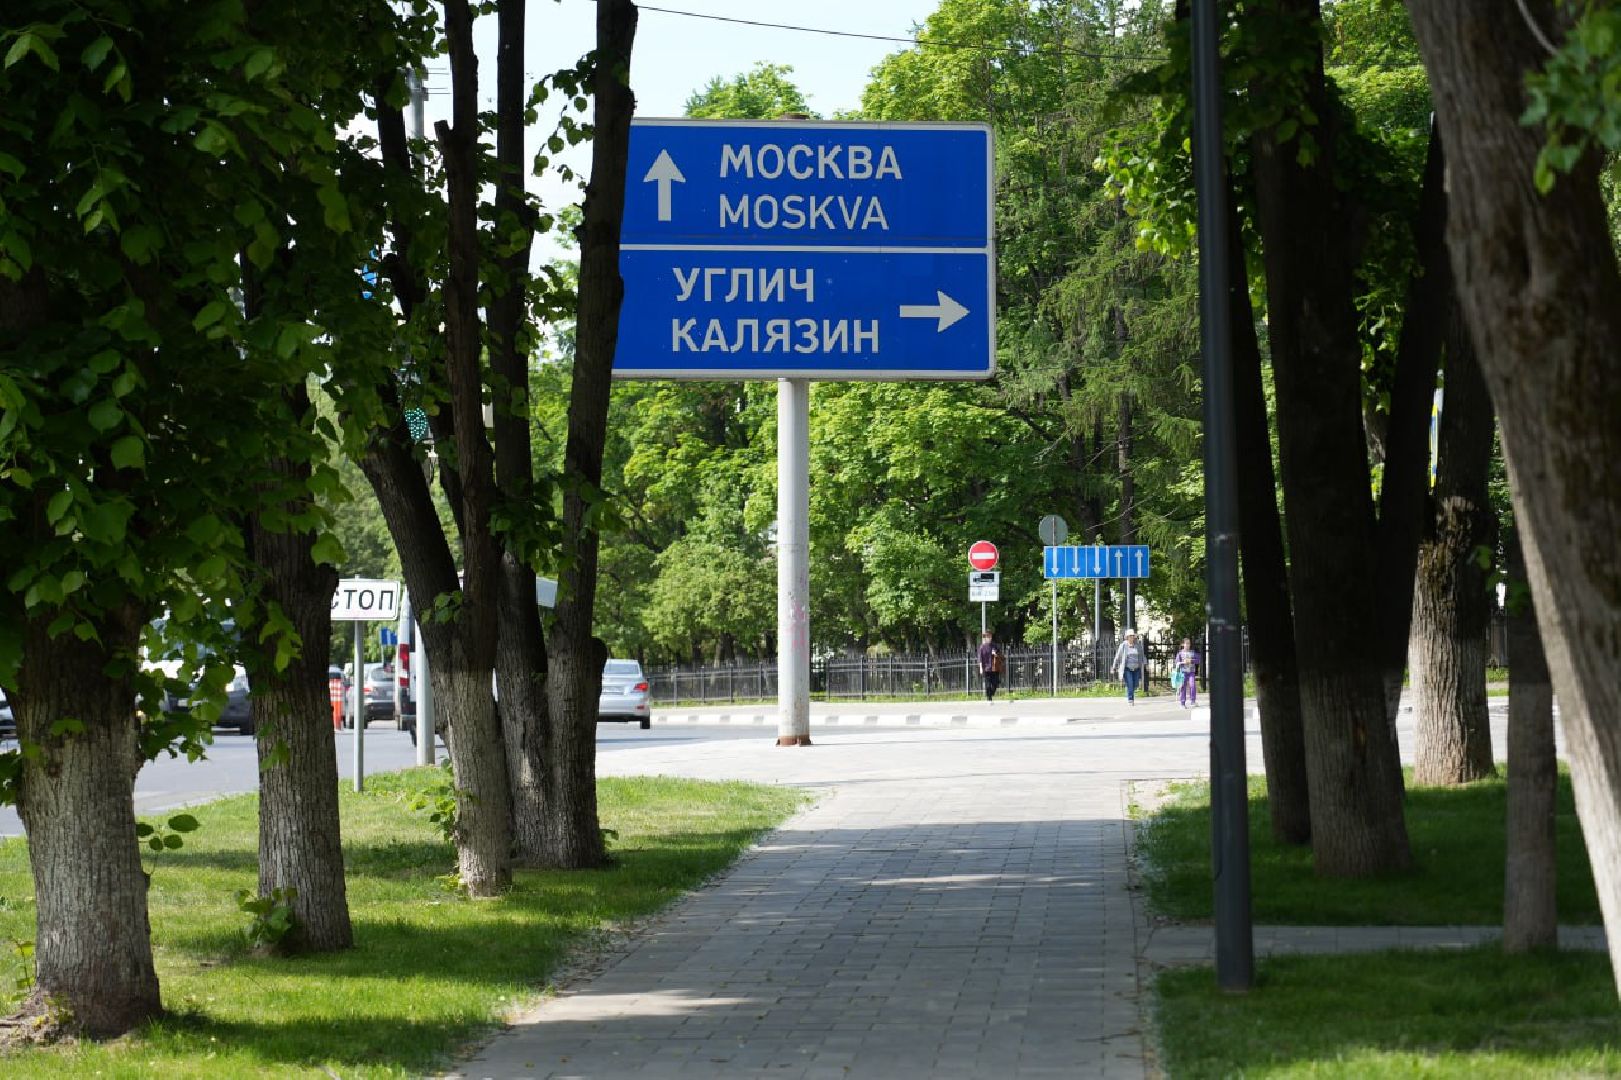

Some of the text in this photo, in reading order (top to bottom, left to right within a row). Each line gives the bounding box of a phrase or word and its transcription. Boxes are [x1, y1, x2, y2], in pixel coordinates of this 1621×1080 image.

[719, 143, 903, 180] МОСКВА
[719, 193, 889, 230] MOSKVA
[672, 267, 814, 303] УГЛИЧ
[672, 318, 879, 354] КАЛЯЗИН
